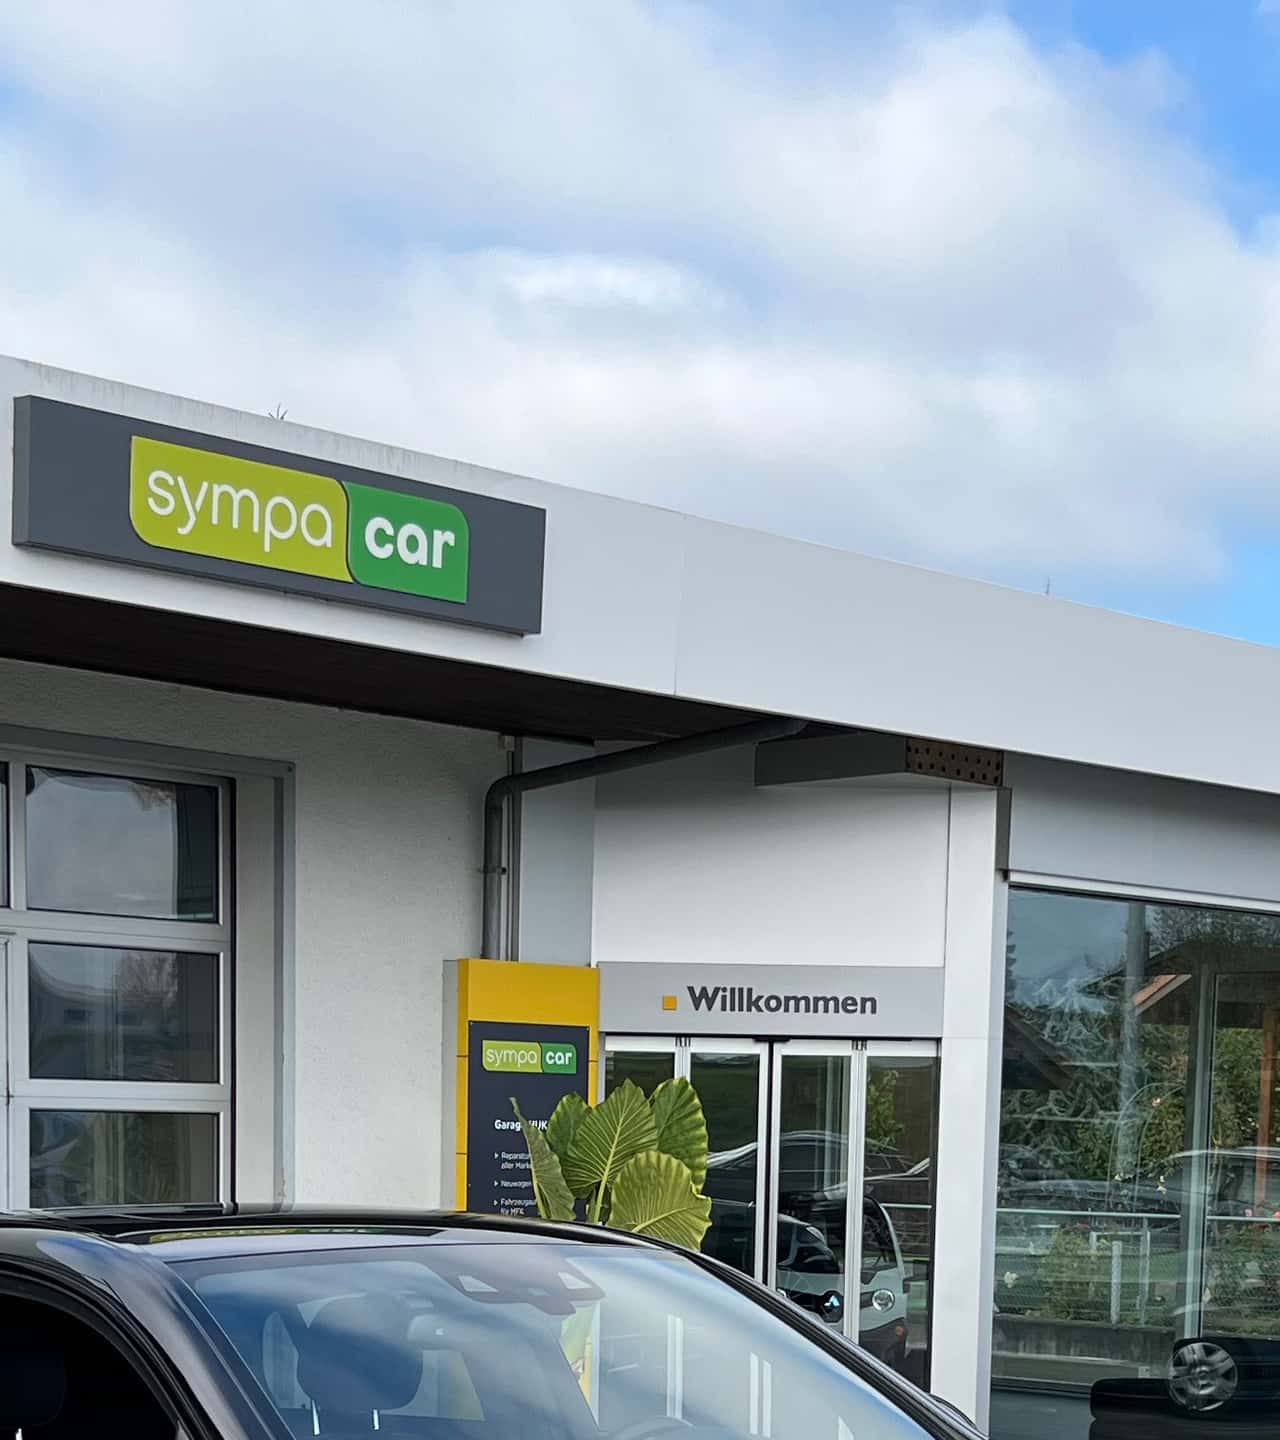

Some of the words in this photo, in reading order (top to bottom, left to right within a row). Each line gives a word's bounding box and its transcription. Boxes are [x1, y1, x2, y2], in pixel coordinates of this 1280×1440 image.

[147, 469, 333, 553] sympa
[364, 516, 456, 569] car
[686, 985, 878, 1015] Willkommen
[486, 1048, 538, 1067] sympa
[545, 1051, 573, 1065] car
[494, 1119, 522, 1132] Garag
